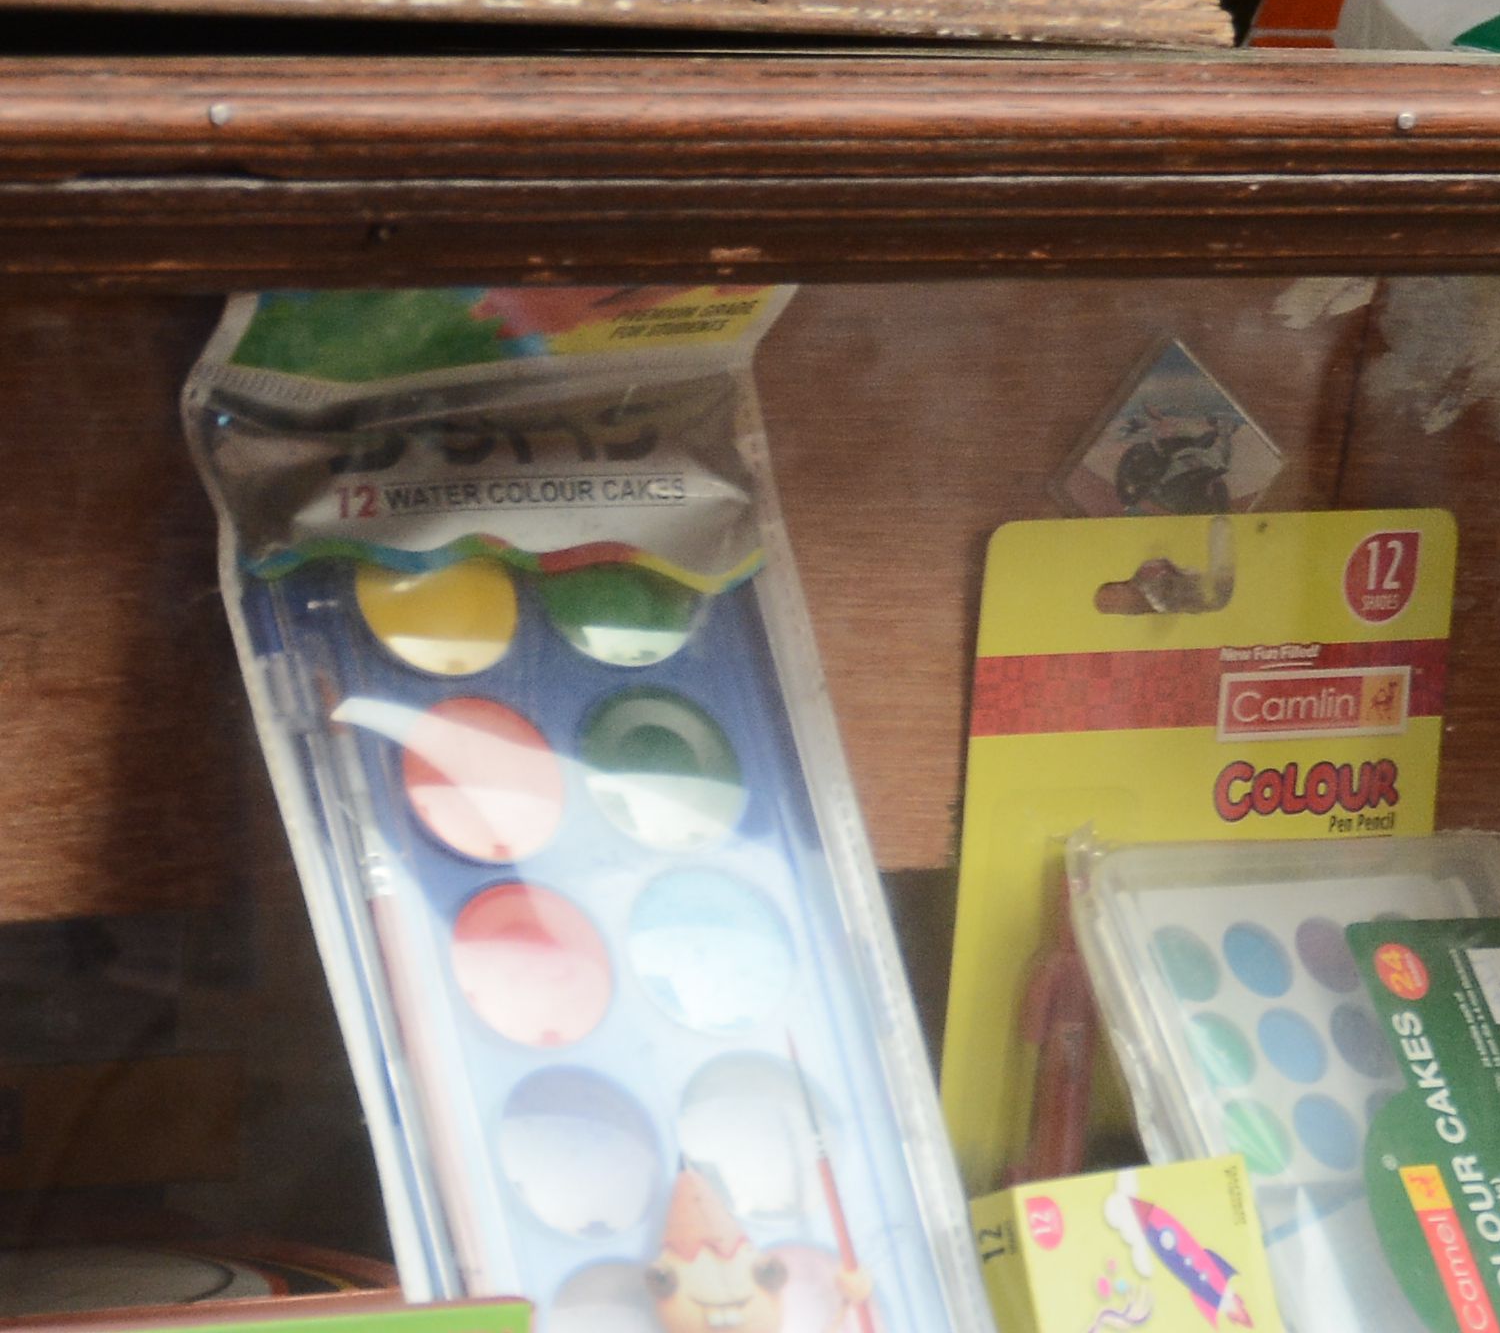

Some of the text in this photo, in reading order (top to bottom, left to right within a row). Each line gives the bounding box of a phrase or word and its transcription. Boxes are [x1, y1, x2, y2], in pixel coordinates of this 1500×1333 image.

[336, 476, 687, 521] 12 WATER COLOUR CAKES
[1365, 539, 1404, 591] 12
[1231, 686, 1357, 724] Camlin
[1391, 1009, 1469, 1145] CAKES
[1427, 1211, 1489, 1332] Camel
